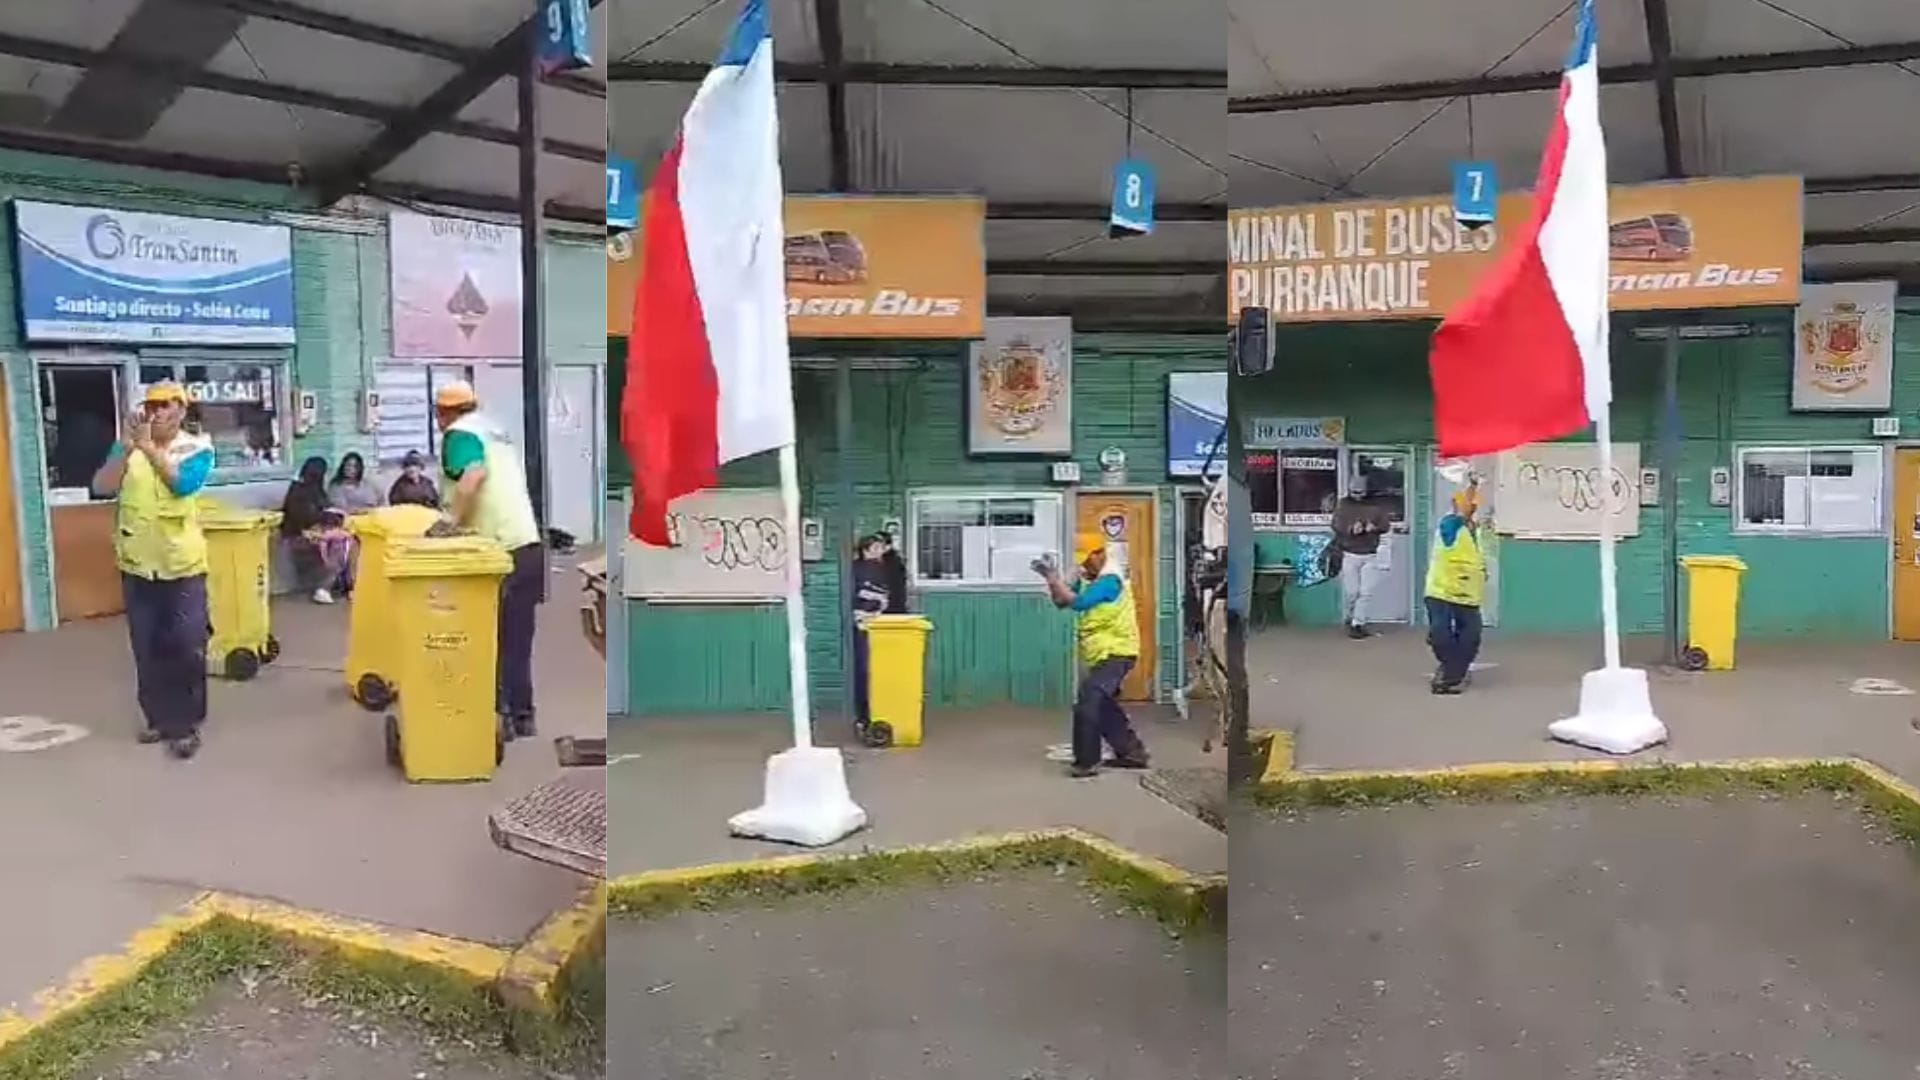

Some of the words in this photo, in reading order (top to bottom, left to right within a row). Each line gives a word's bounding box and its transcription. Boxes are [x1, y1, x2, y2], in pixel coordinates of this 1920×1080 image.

[547, 1, 563, 43] 9
[1125, 172, 1141, 209] 8
[1466, 170, 1483, 203] 7
[1333, 208, 1377, 258] DE
[1231, 260, 1430, 315] PURRANQUE
[1694, 263, 1783, 287] Bus
[54, 295, 126, 319] Santiago
[129, 297, 181, 318] directo
[868, 289, 961, 316] Bus
